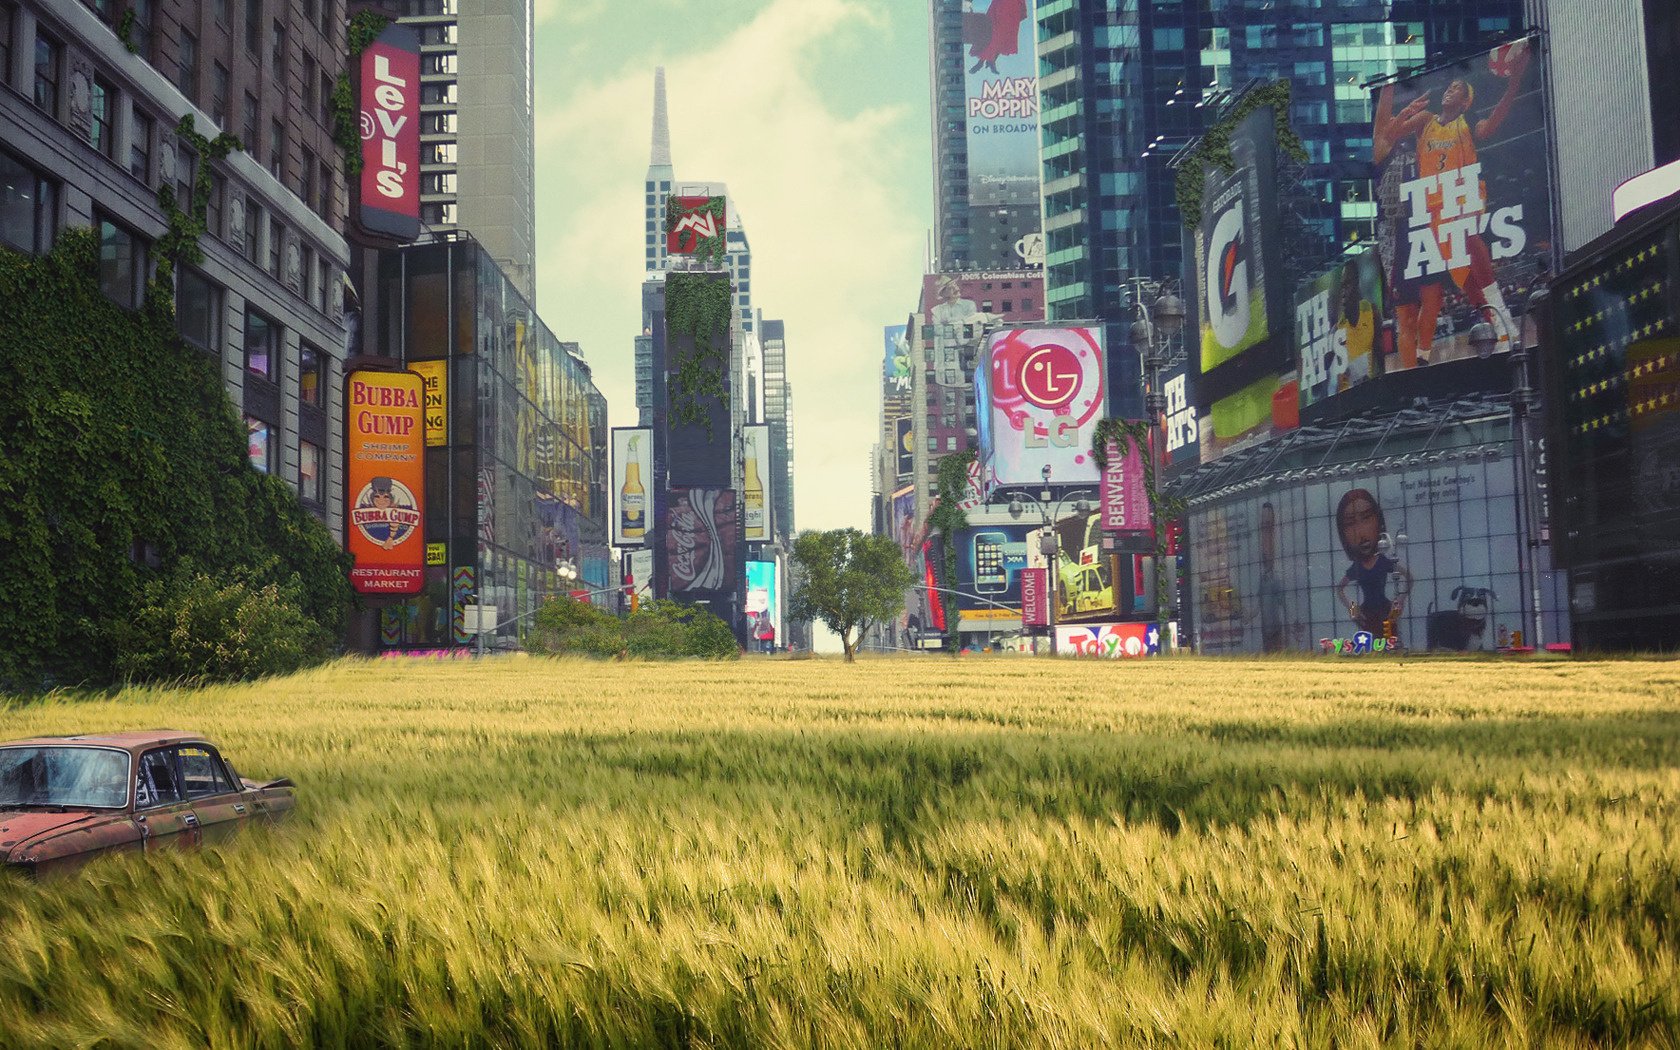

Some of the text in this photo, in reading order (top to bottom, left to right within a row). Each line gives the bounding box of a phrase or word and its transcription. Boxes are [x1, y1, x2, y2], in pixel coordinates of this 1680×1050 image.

[982, 76, 1038, 99] MARY
[973, 125, 989, 134] ON
[1399, 162, 1485, 228] TH
[1404, 204, 1527, 280] AT'S
[982, 272, 1025, 280] Colombian
[1297, 289, 1330, 346] TH
[1300, 327, 1349, 391] AT'S
[353, 381, 419, 408] BUBBA
[1164, 373, 1187, 416] TH
[358, 410, 415, 436] GUMP
[1024, 415, 1079, 449] LG
[1167, 406, 1198, 453] AT'S
[356, 453, 416, 461] COMPANY
[363, 442, 409, 450] SHRIMP
[1107, 436, 1126, 526] BENVENUT
[354, 509, 419, 524] BUBBA GUMP
[670, 508, 696, 580] Coca-Cola
[352, 568, 420, 577] RESTAURANT
[364, 580, 409, 588] MARKET
[1025, 572, 1036, 622] WELCOME
